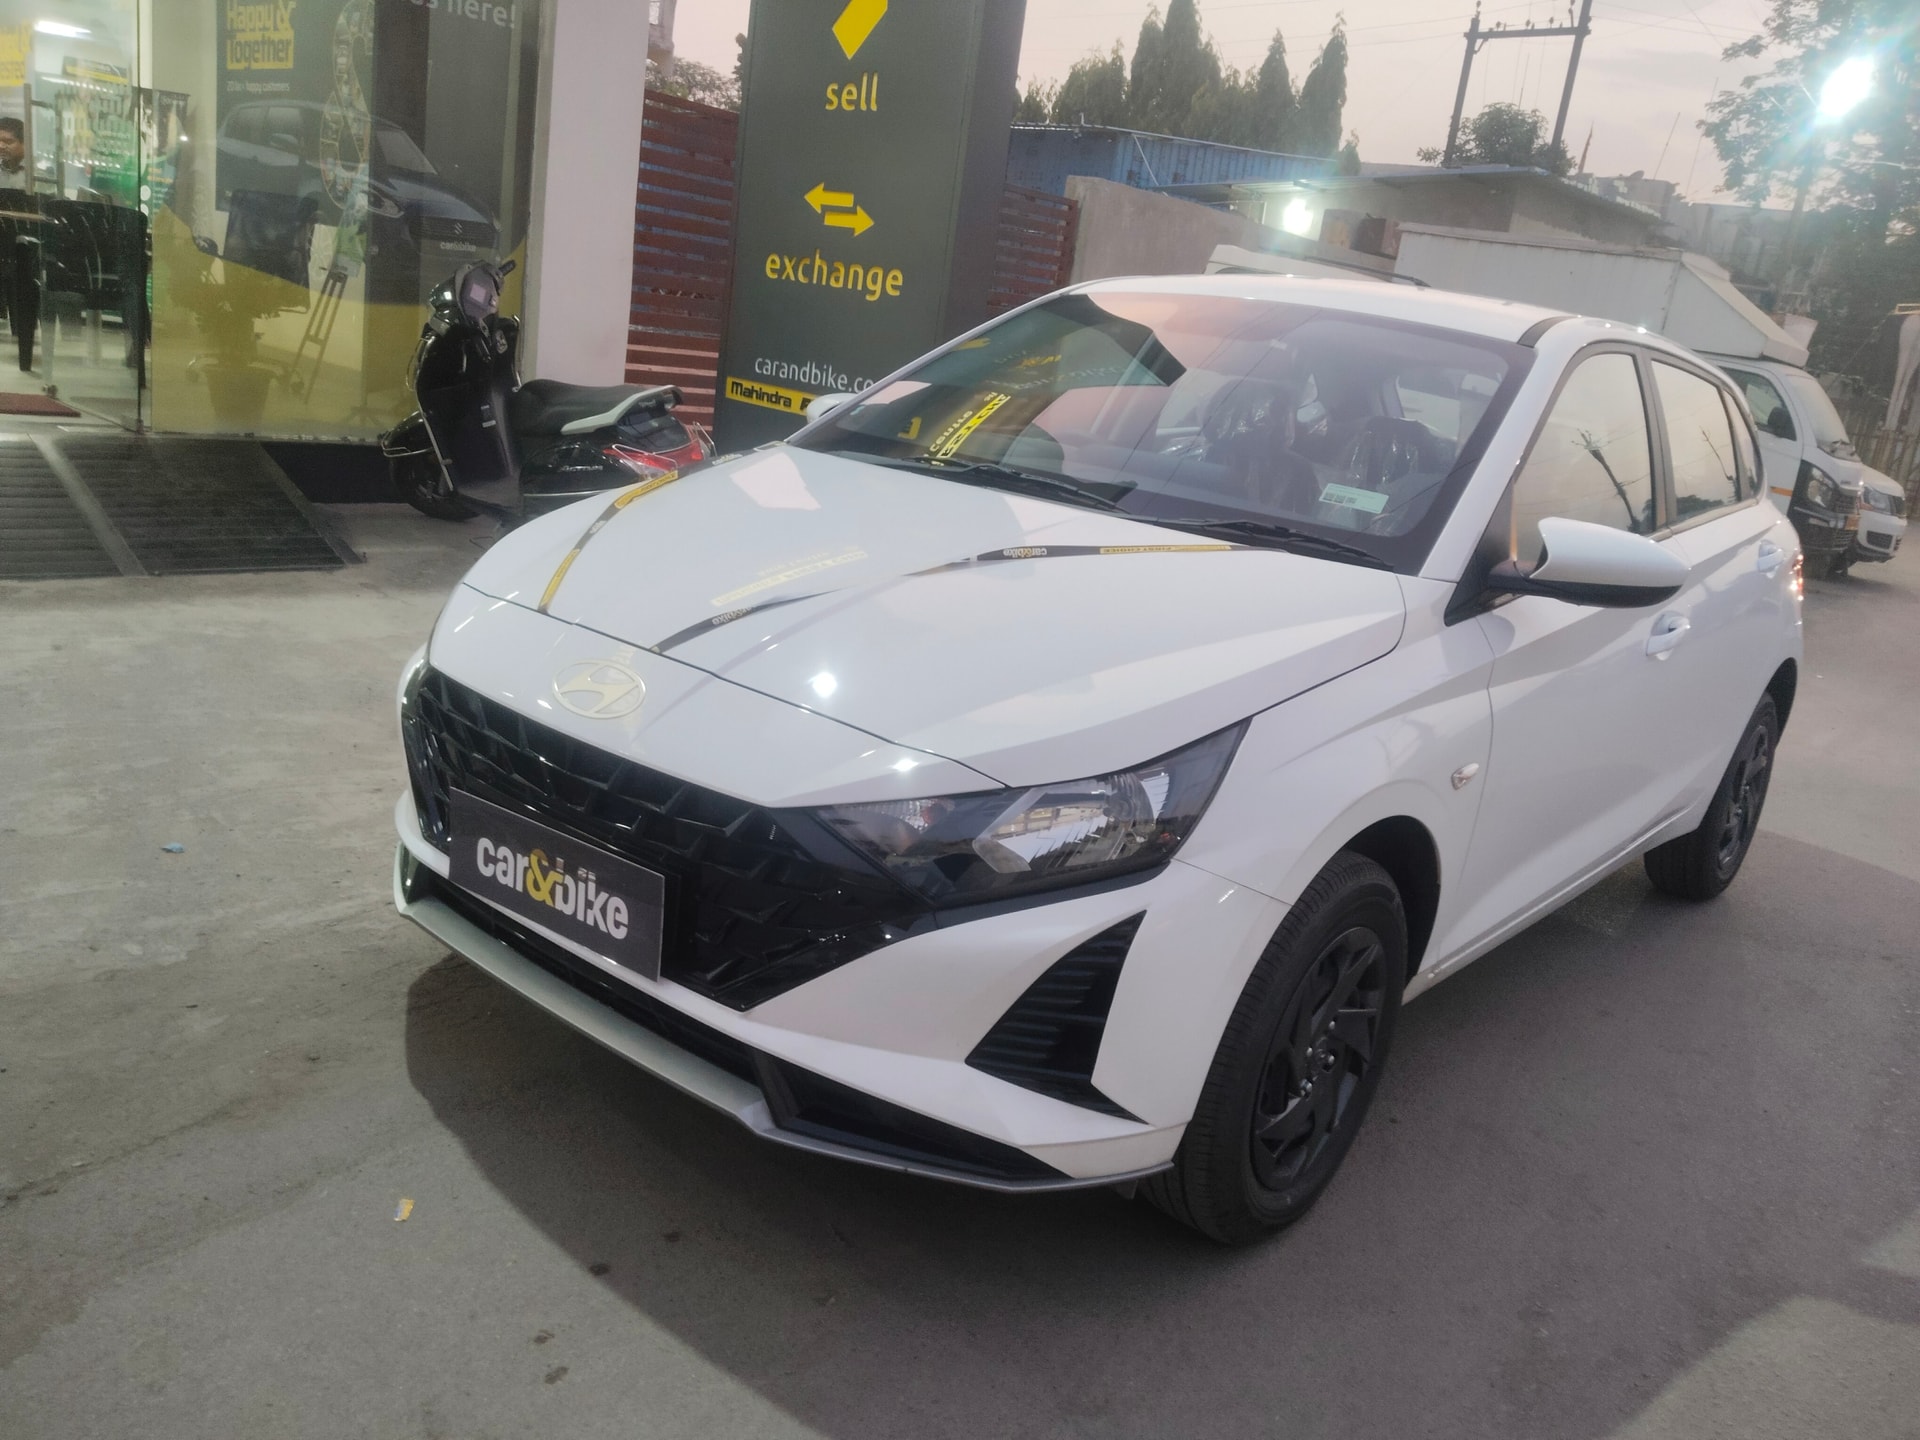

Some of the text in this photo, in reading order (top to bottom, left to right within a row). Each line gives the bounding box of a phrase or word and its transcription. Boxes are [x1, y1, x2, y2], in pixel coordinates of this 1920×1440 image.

[227, 0, 274, 33] Happy
[227, 35, 292, 70] Together
[825, 70, 879, 112] sell
[766, 248, 904, 302] exchange
[754, 357, 874, 394] carandbike.co
[730, 380, 793, 409] Mahindra
[476, 837, 629, 940] car&bike
